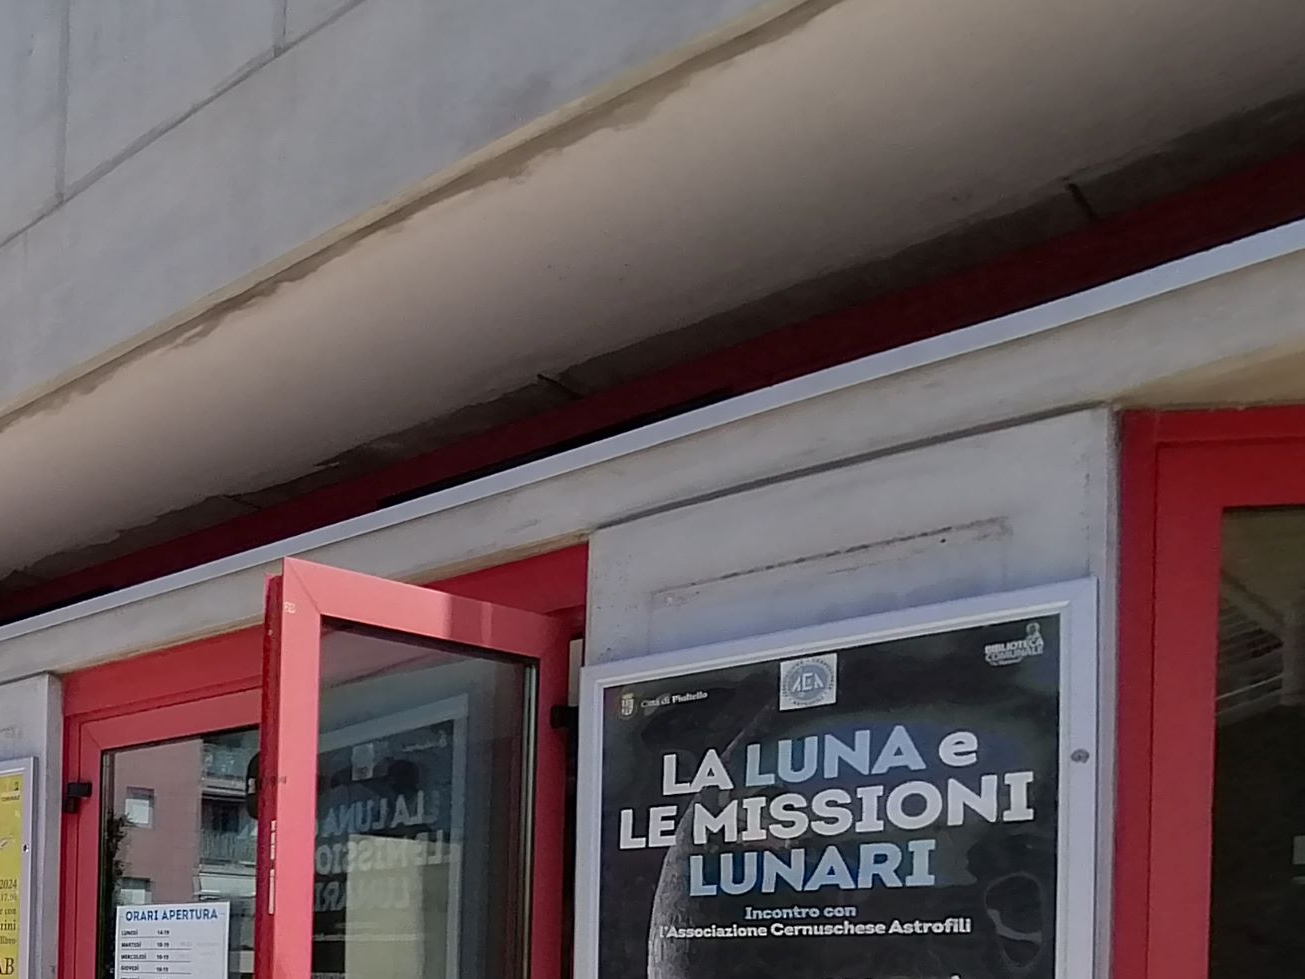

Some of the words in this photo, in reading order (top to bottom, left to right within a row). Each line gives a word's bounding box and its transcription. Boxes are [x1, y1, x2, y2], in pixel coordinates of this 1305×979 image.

[662, 748, 733, 796] LA
[744, 725, 926, 788] LUNA
[938, 729, 978, 767] e
[619, 805, 678, 849] LE
[693, 771, 1034, 845] MISSIONI
[689, 839, 936, 897] LUNARI
[125, 910, 158, 921] ORARI
[161, 908, 218, 920] APERTURA
[659, 924, 768, 939] l'Associazione
[770, 920, 887, 936] Cernuschese
[888, 918, 971, 934] Astrofili
[745, 905, 820, 920] Incontro
[823, 905, 857, 918] con
